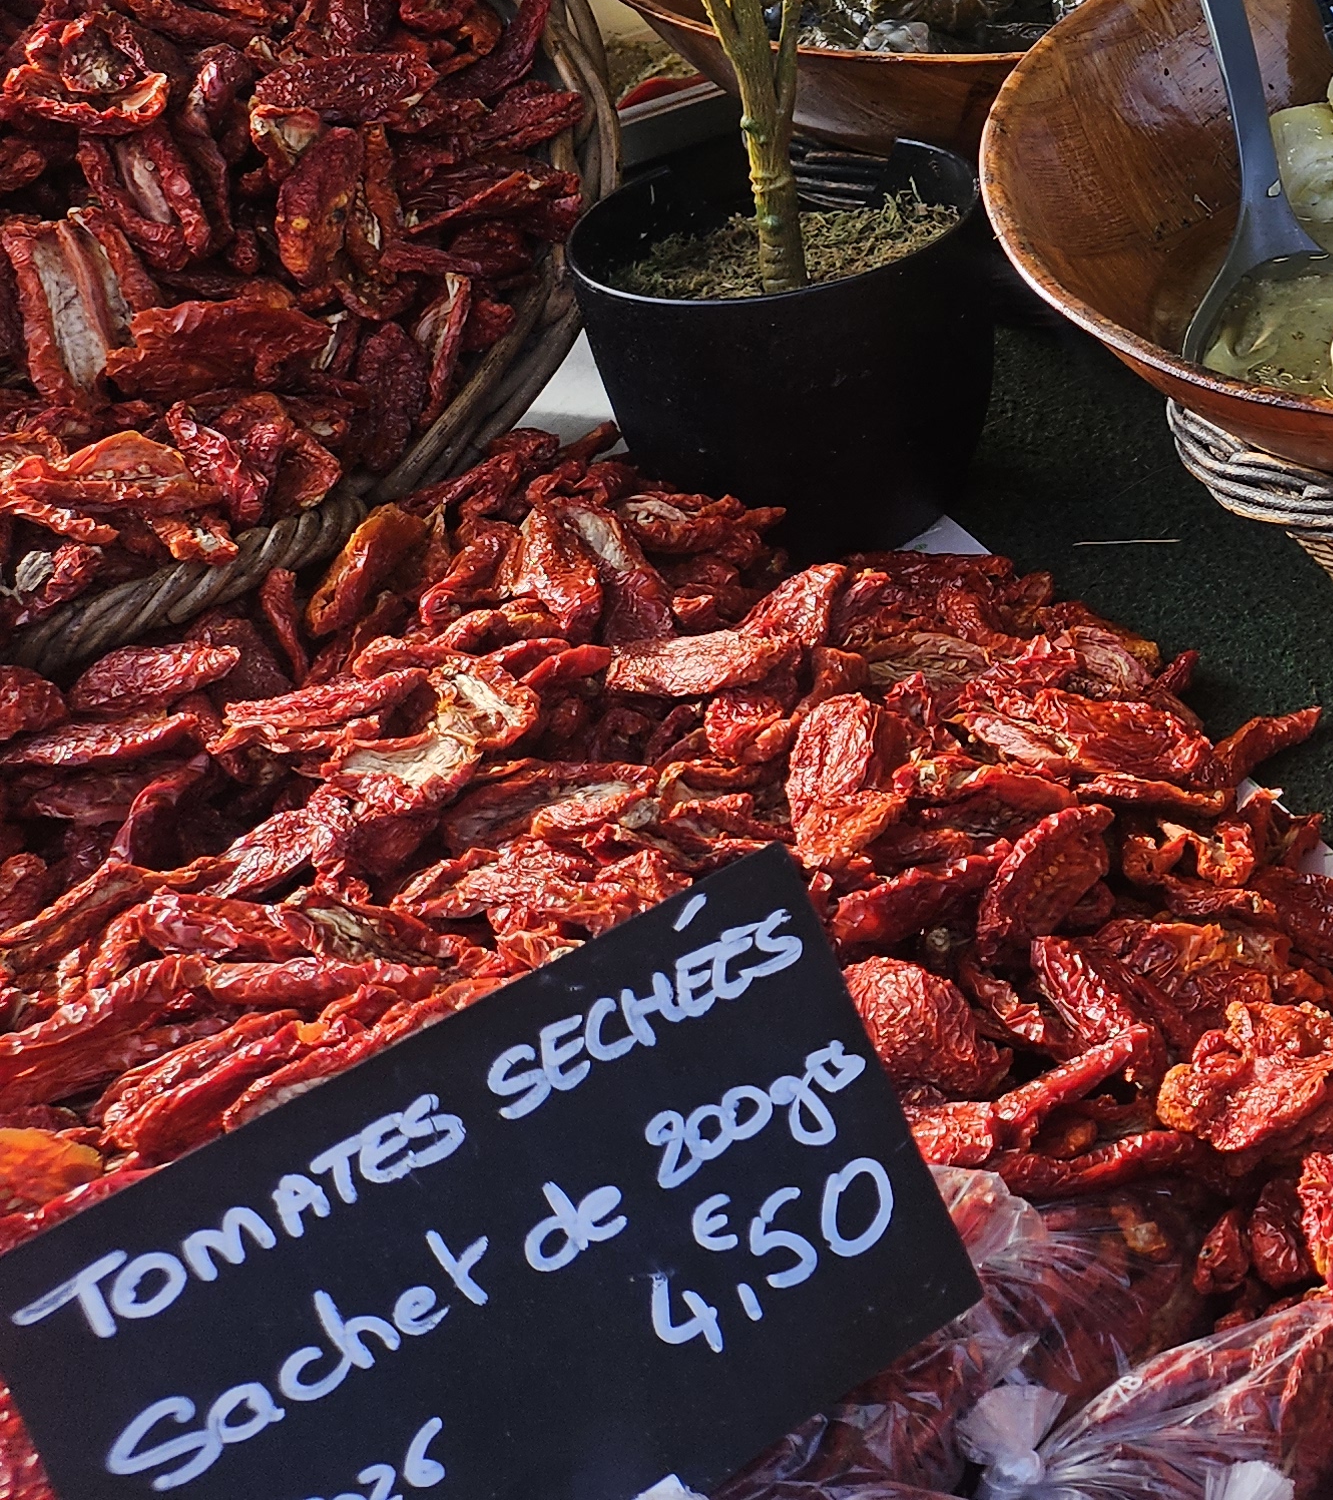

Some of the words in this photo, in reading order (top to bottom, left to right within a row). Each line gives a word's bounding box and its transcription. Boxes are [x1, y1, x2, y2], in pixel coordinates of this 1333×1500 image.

[10, 1093, 468, 1339] TOMATES
[105, 1229, 490, 1492] Sachet
[524, 1180, 628, 1273] de
